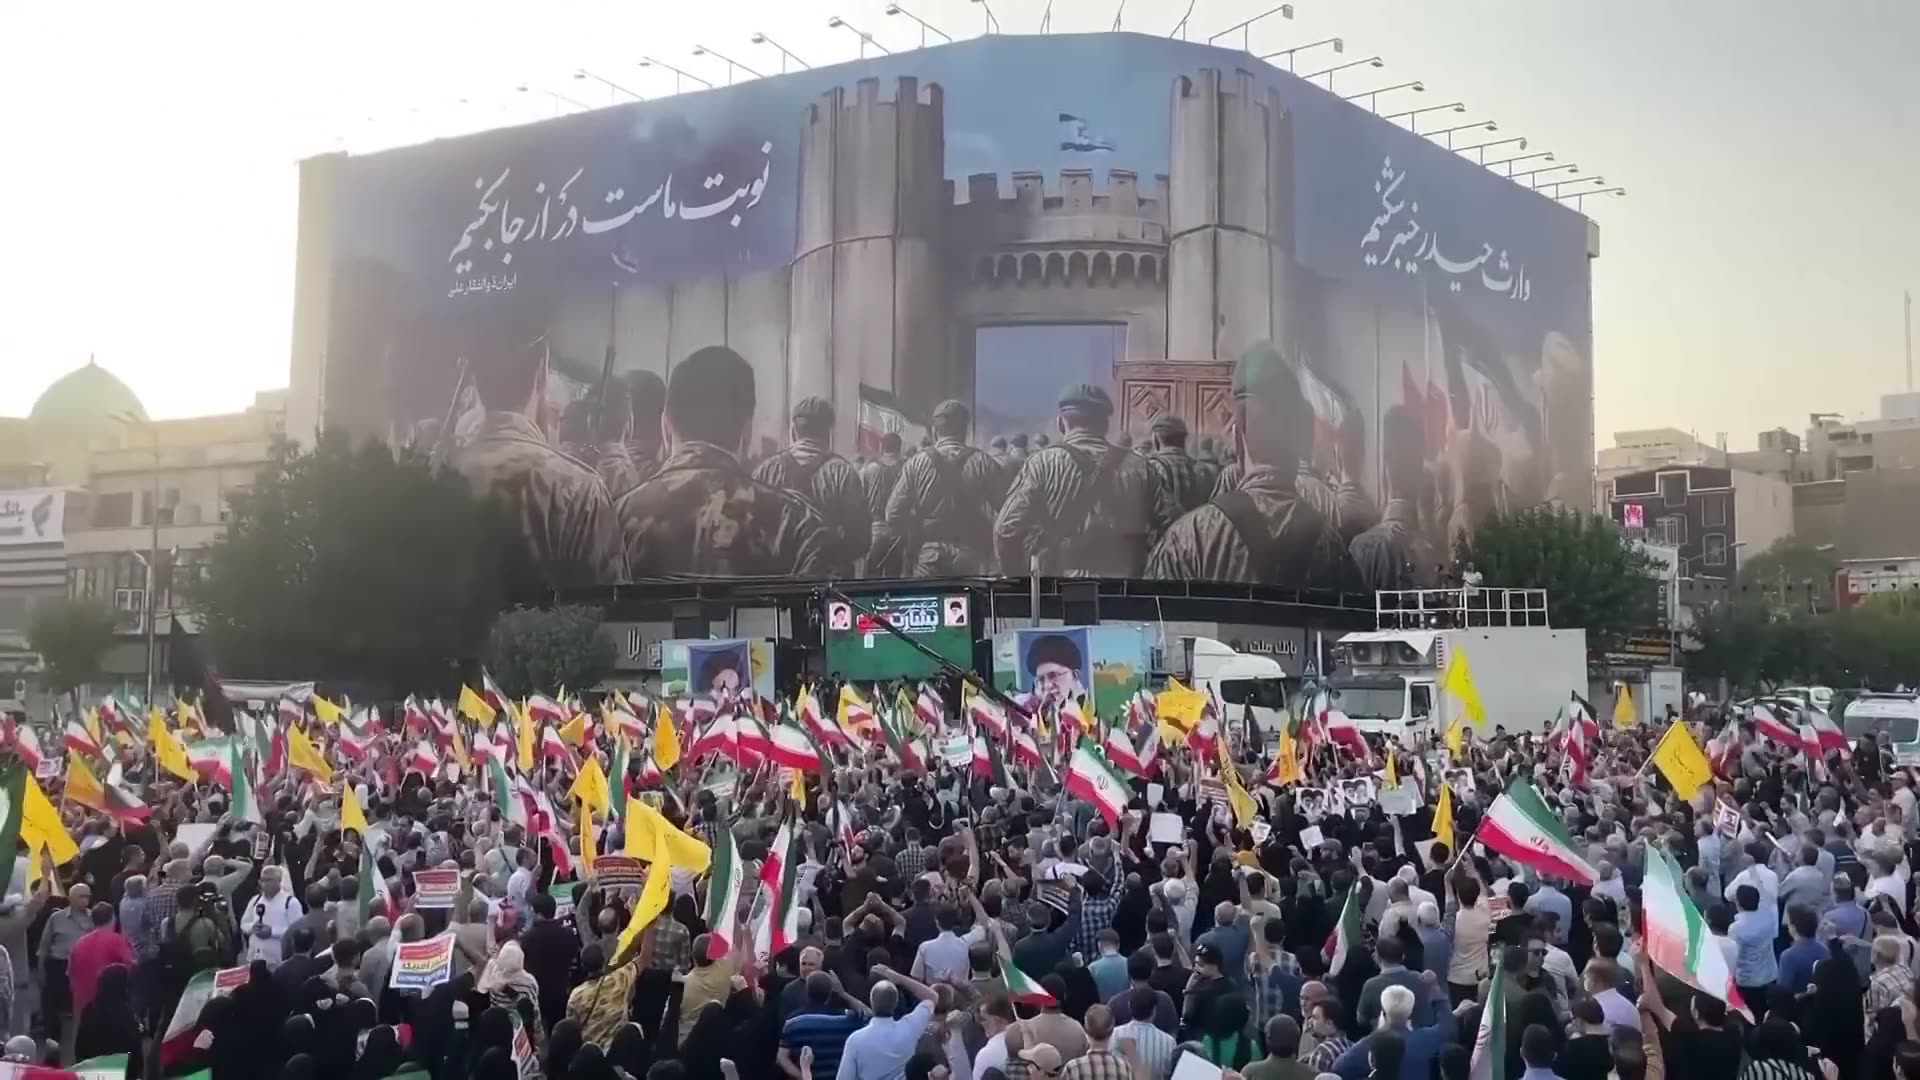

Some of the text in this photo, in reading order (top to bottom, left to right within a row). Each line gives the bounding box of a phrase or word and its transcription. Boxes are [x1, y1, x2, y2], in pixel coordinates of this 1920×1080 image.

[523, 181, 551, 241] از
[583, 173, 677, 234] ماست
[680, 141, 773, 227] نوبت
[1380, 201, 1421, 275] خیبر
[1415, 231, 1494, 292] حیدر
[1482, 250, 1531, 302] وارث
